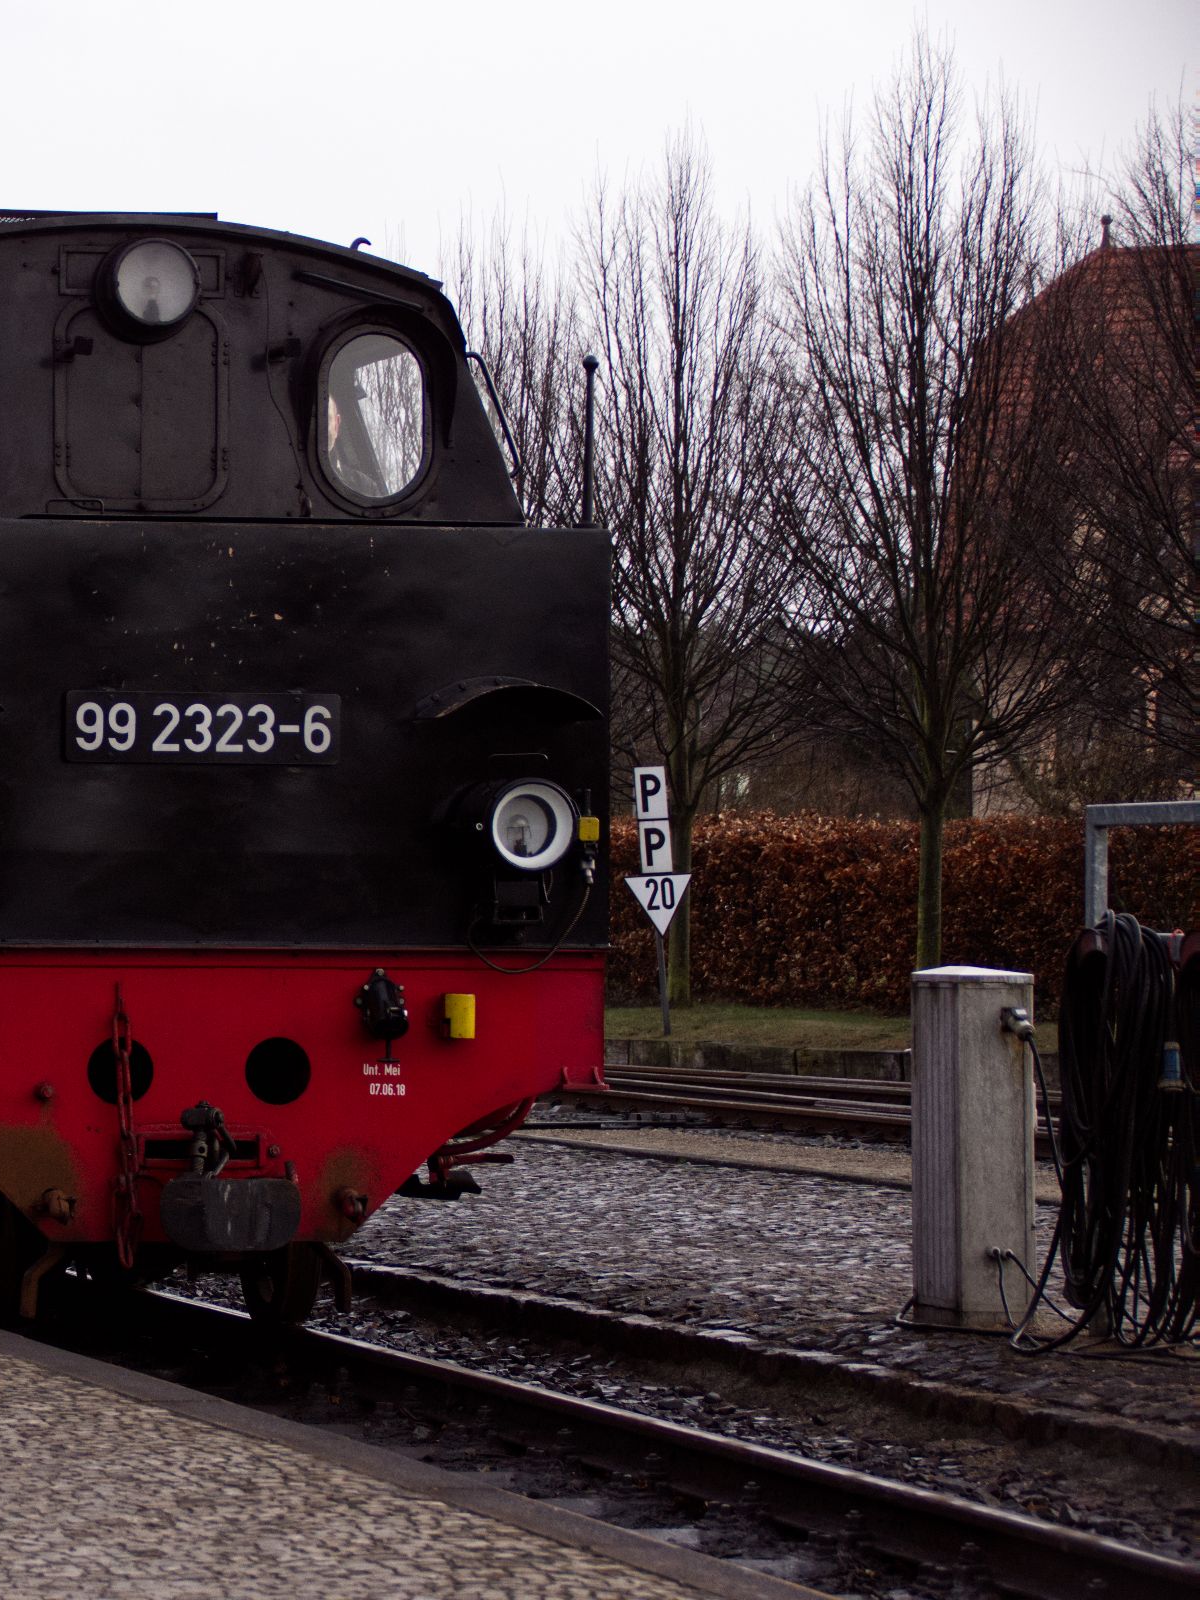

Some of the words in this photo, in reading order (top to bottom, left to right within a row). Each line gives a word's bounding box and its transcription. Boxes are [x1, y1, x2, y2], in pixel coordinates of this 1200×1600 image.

[76, 702, 136, 751] 99
[152, 703, 332, 754] 2323-6
[640, 774, 661, 812] P
[644, 828, 665, 866] P
[645, 877, 676, 911] 20
[363, 1063, 381, 1076] Unt.
[384, 1063, 400, 1076] Mei
[369, 1083, 406, 1096] 07.06.18
